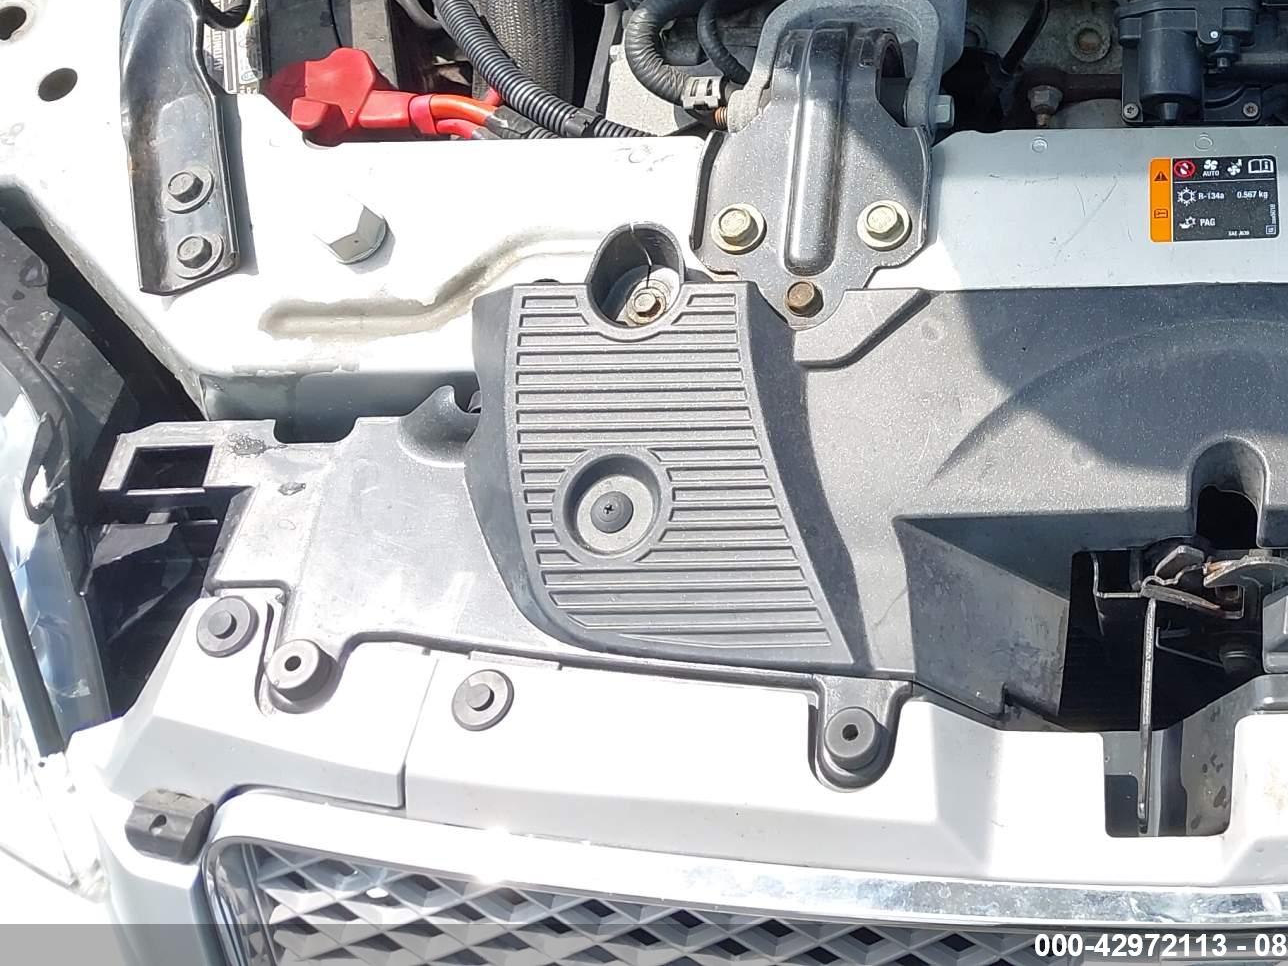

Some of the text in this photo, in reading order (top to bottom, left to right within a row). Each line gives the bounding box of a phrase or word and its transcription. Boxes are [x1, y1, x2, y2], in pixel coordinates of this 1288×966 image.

[1198, 191, 1269, 200] R-134a 0.567 kg
[1199, 218, 1216, 227] PAG
